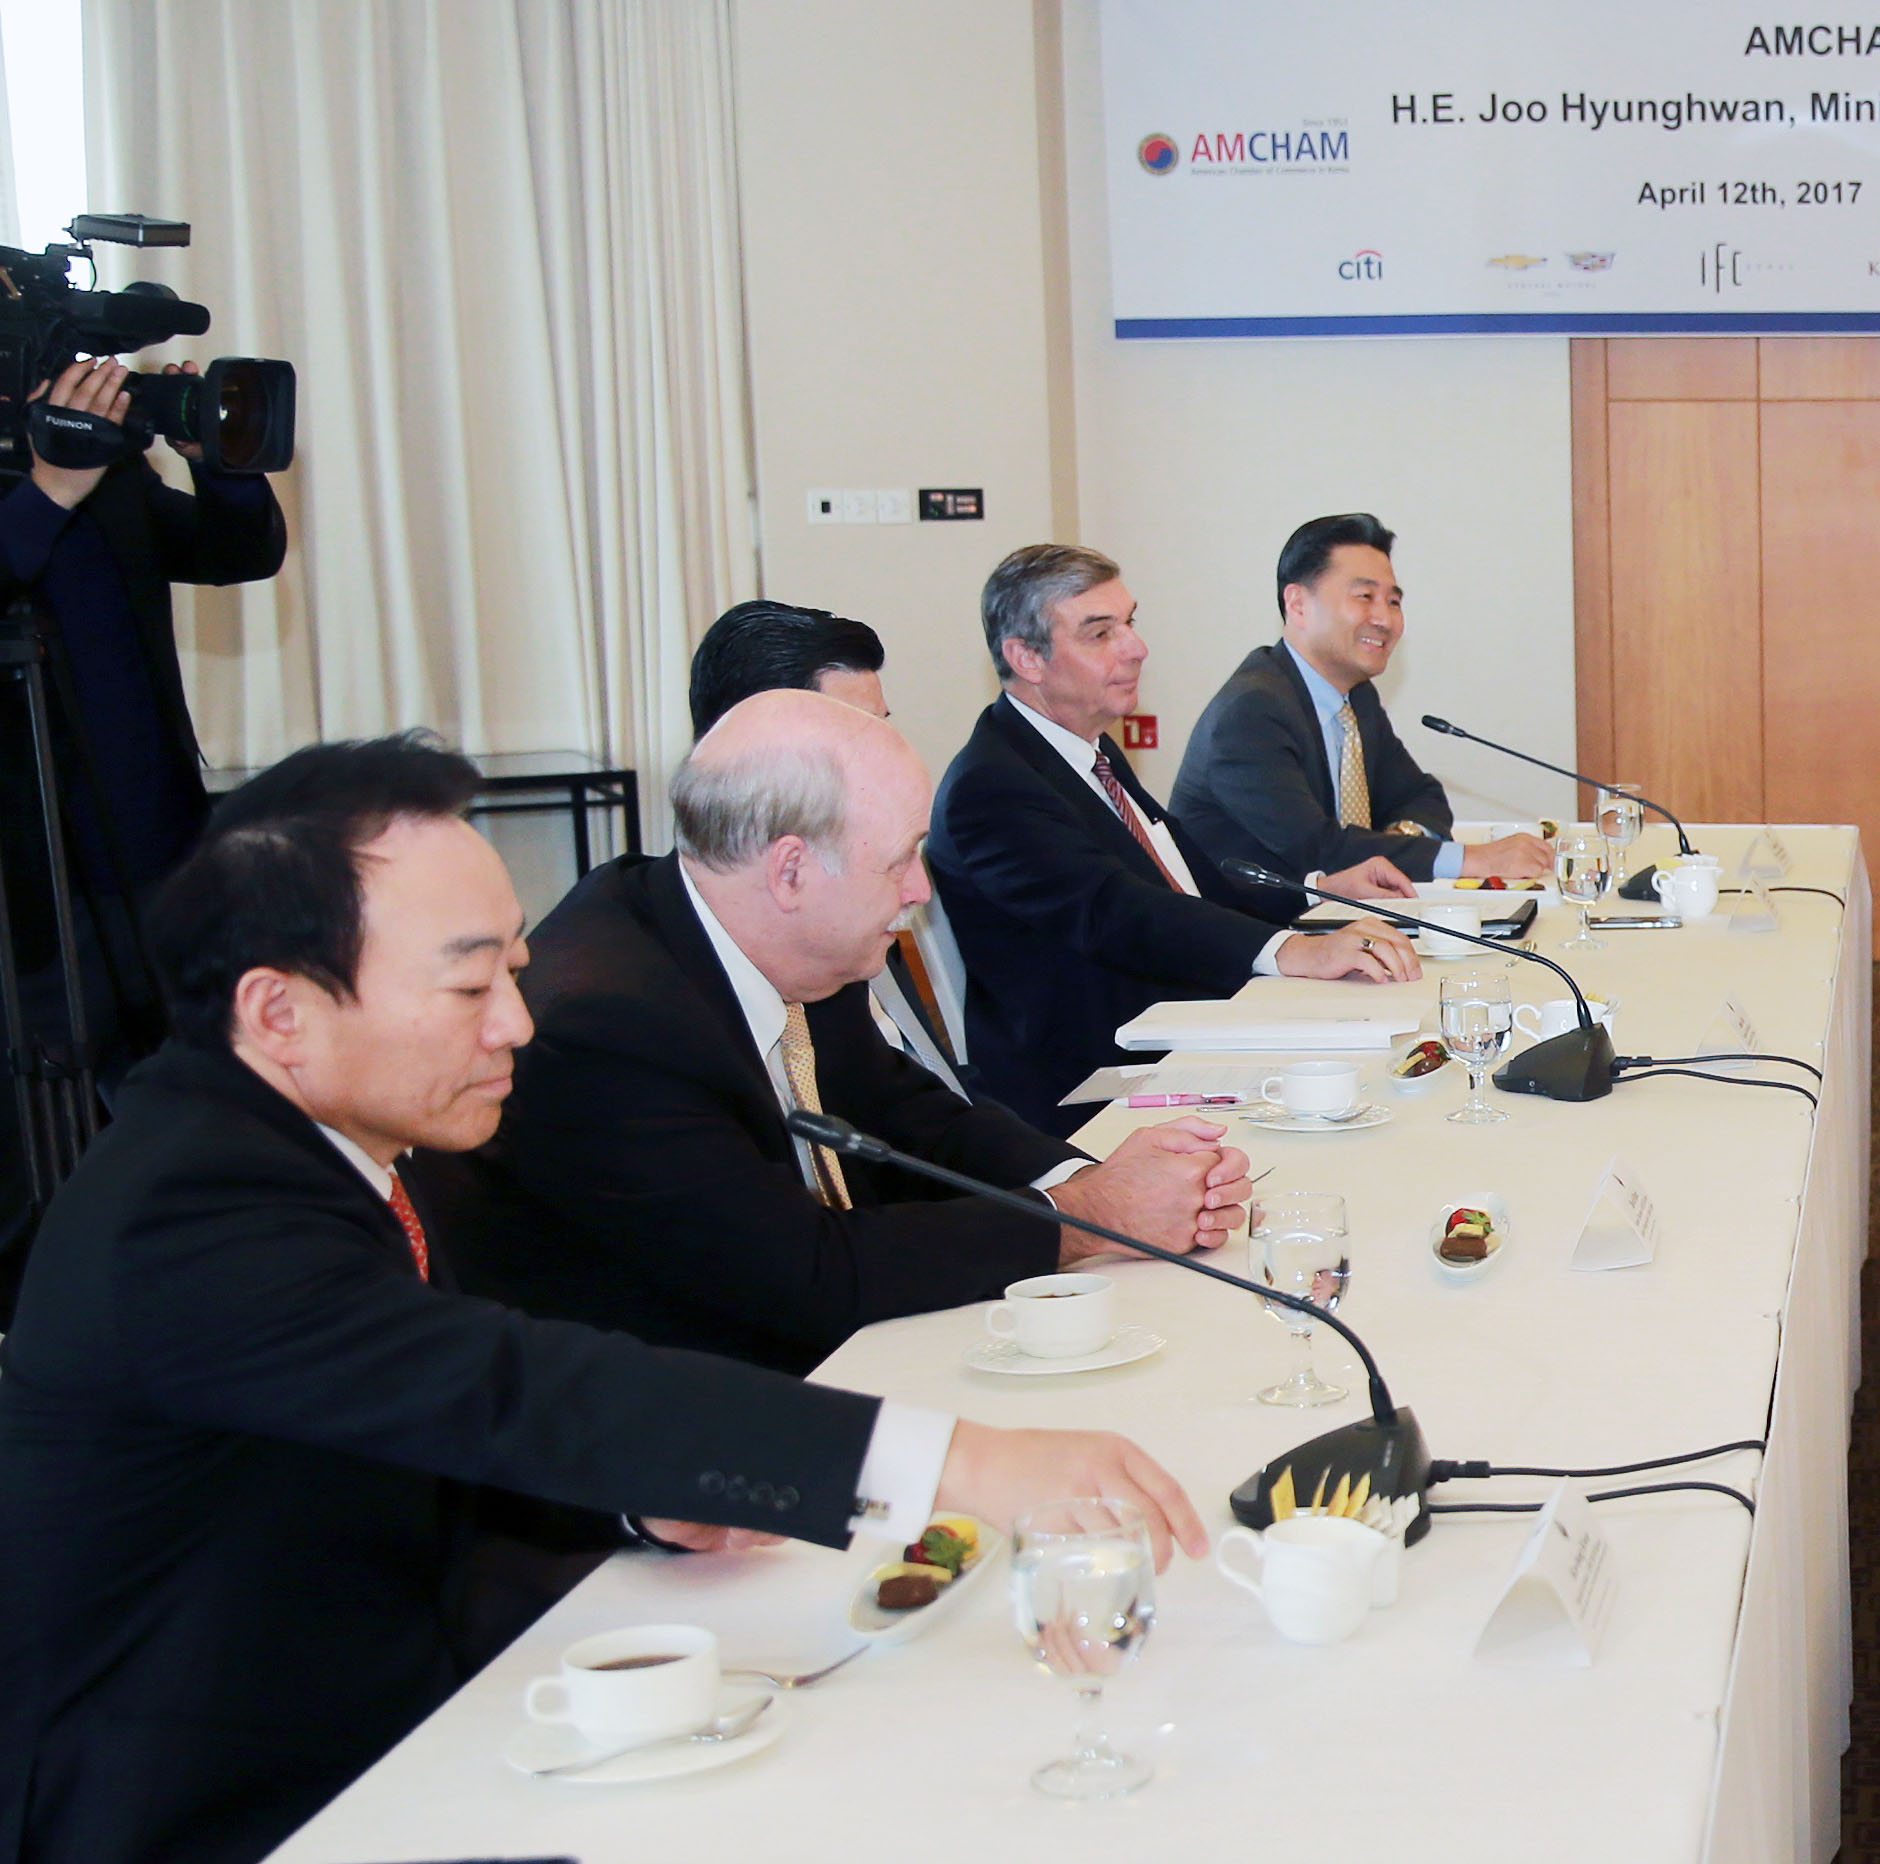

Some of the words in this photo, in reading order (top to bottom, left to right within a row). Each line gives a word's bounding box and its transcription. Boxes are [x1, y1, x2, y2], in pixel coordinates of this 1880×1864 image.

[1391, 92, 1466, 124] H.E.
[1479, 92, 1549, 124] Joo
[1561, 91, 1796, 132] Hyunghwan,
[1191, 131, 1349, 163] AMCHAM
[1637, 181, 1706, 210] April
[1718, 181, 1786, 209] 12th,
[1797, 181, 1863, 205] 2017
[1338, 254, 1383, 281] citi
[1701, 242, 1742, 294] IFC
